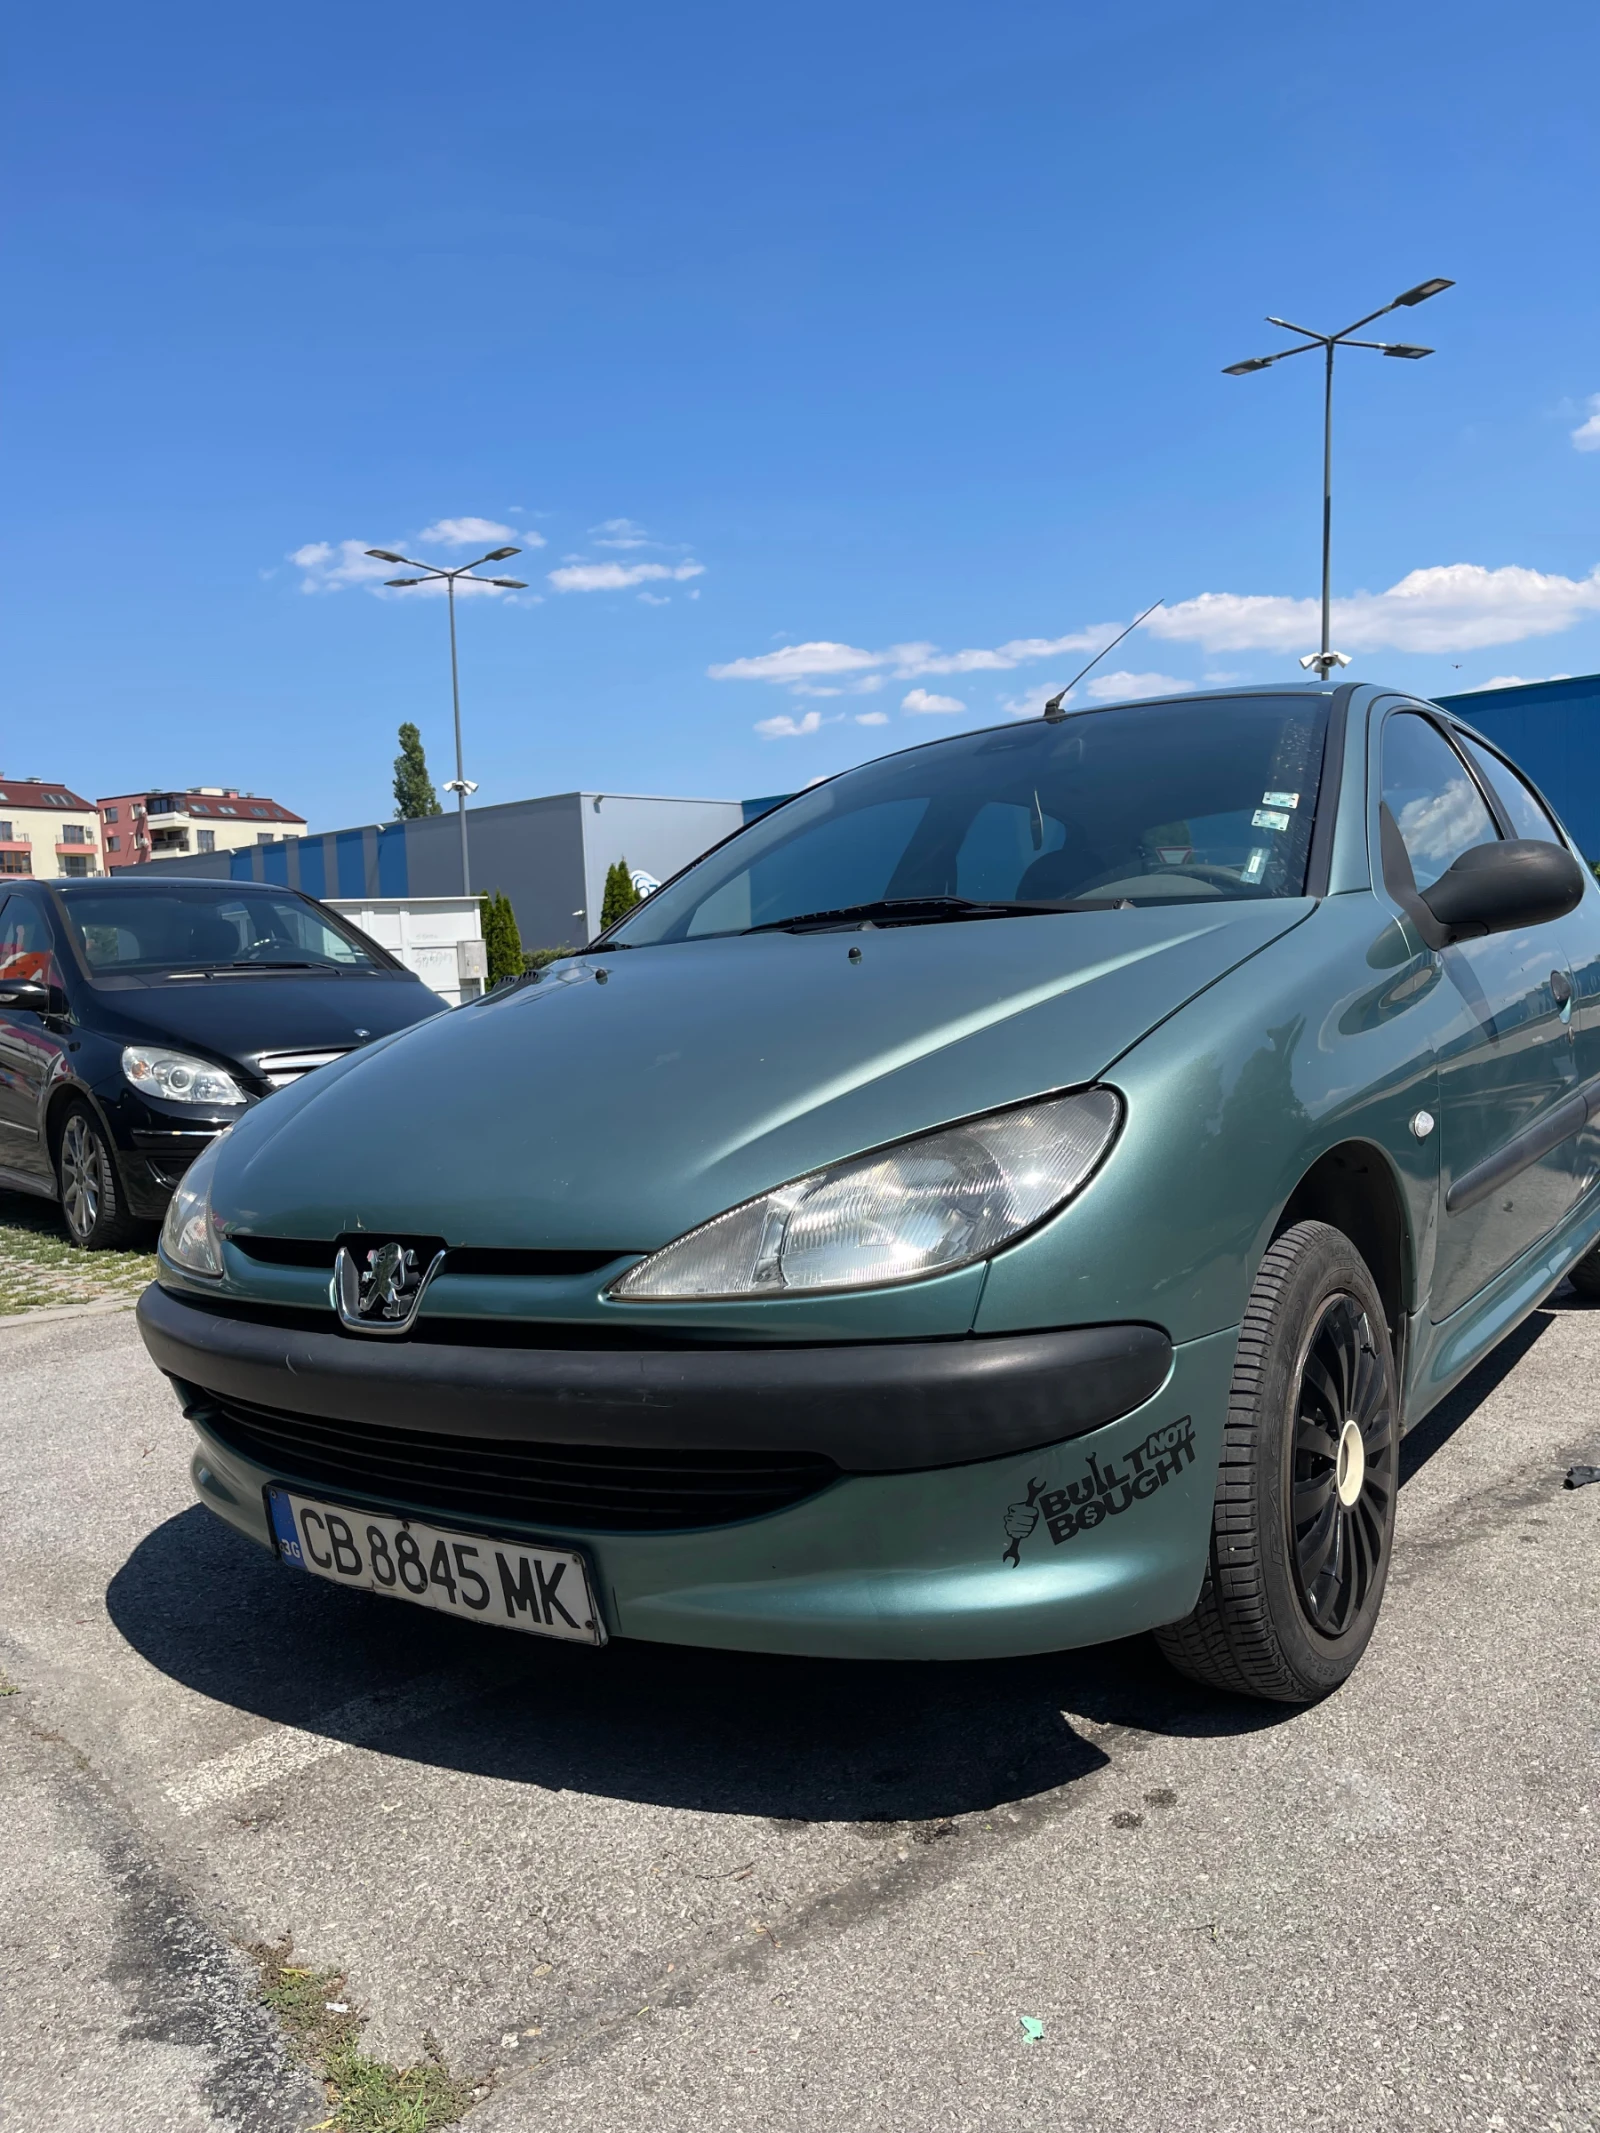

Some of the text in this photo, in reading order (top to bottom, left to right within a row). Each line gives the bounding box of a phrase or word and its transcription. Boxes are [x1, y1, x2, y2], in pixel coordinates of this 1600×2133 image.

[1039, 1416, 1192, 1520] BUILT NOT
[1047, 1431, 1196, 1545] BOUGHT
[300, 1508, 581, 1629] CB 8845 MK
